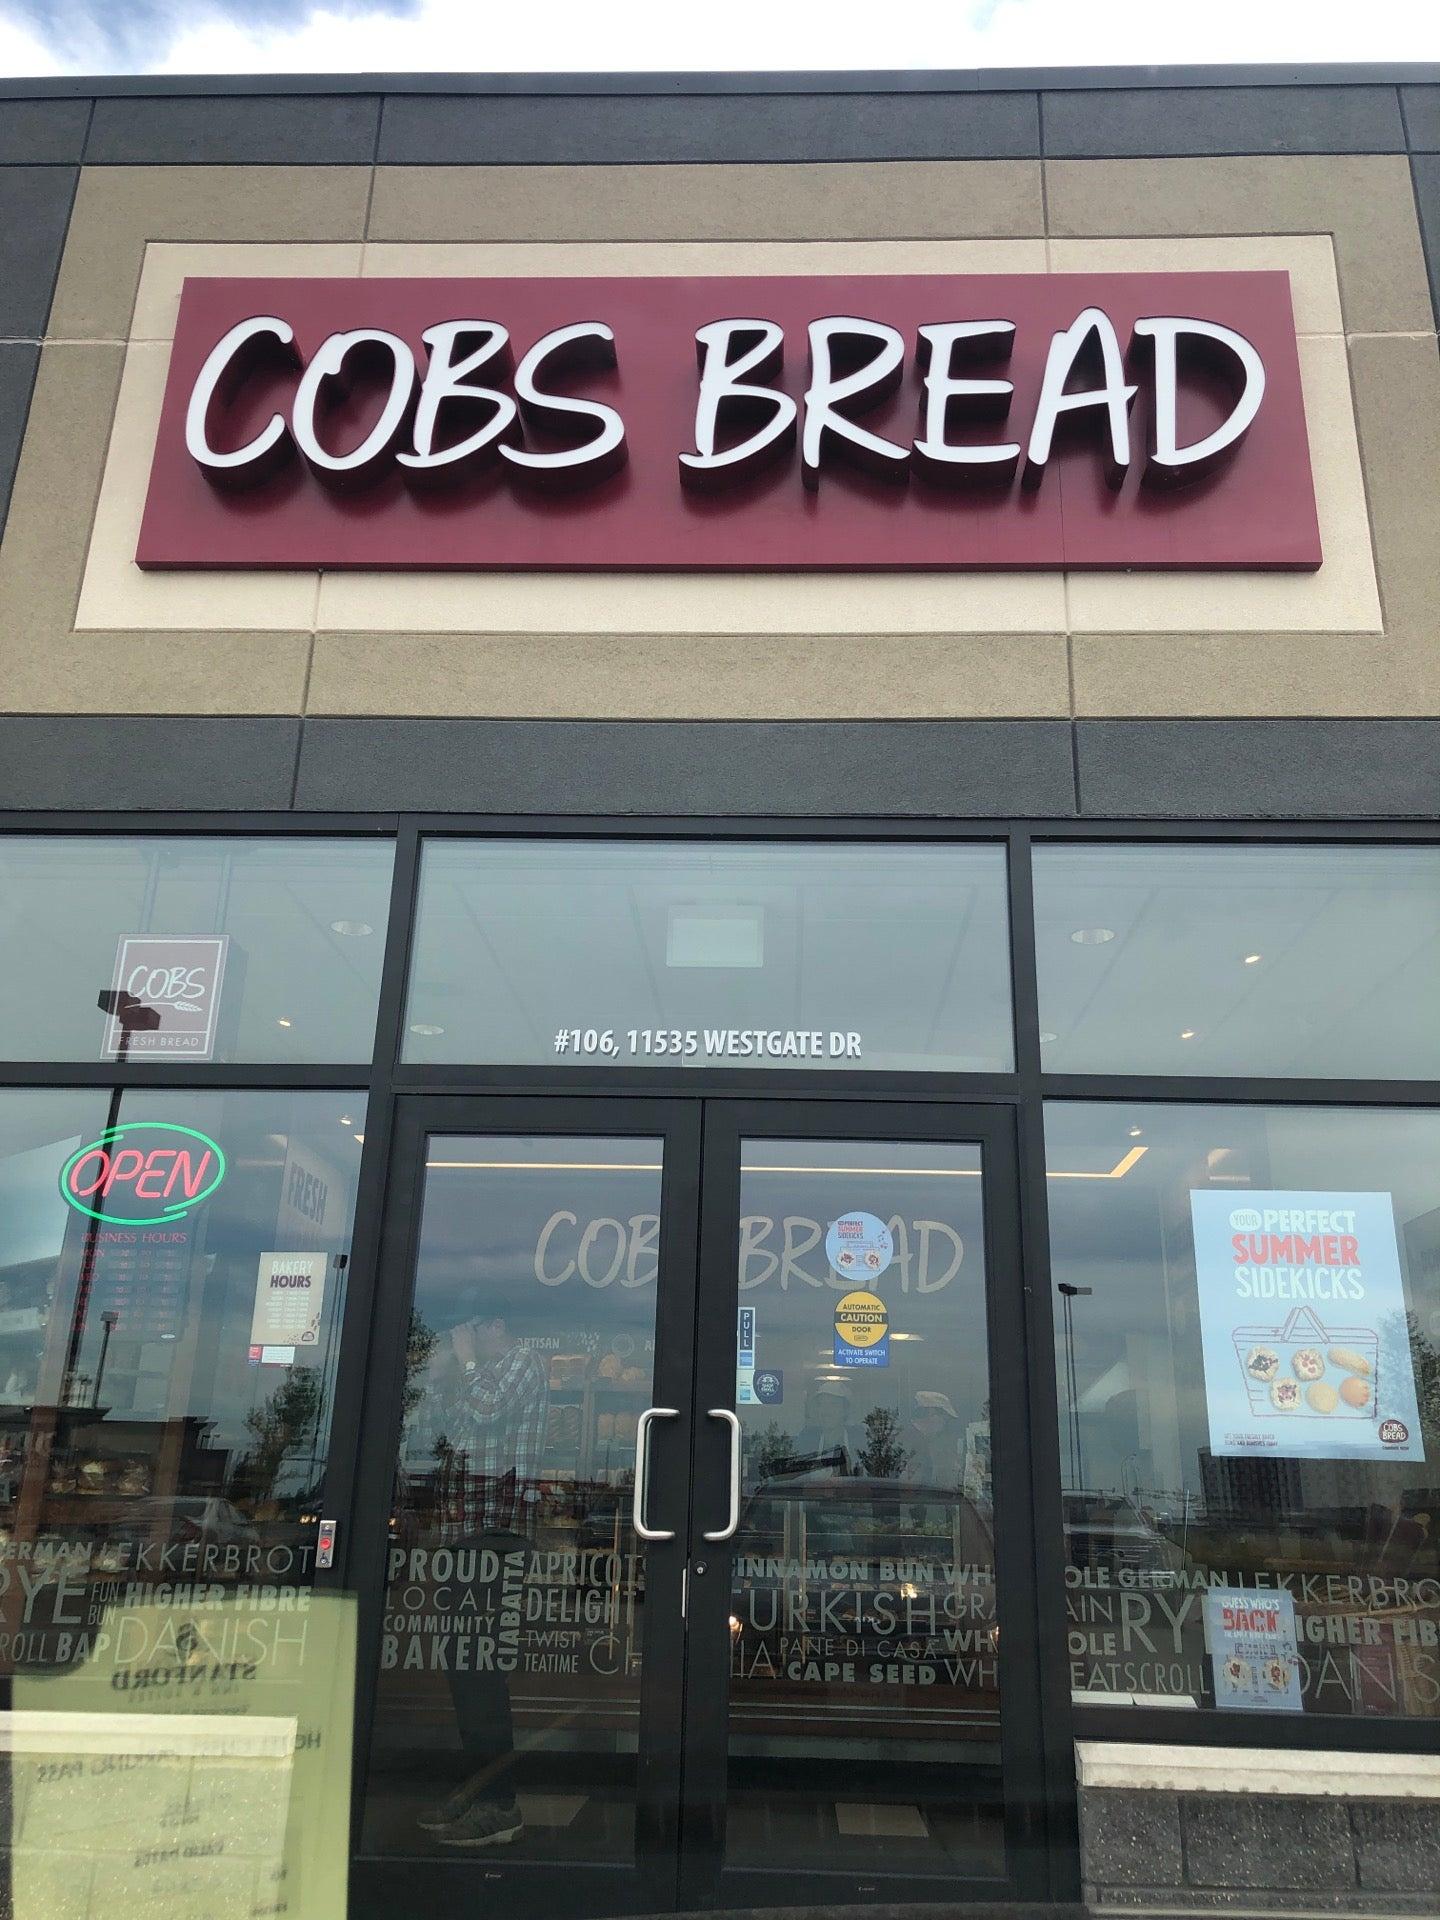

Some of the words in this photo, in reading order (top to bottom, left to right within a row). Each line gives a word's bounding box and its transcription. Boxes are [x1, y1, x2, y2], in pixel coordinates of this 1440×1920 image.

[184, 314, 627, 472] COBS
[677, 305, 1268, 472] BREAD
[126, 964, 206, 999] COBS
[119, 1036, 156, 1046] FRESH
[160, 1037, 199, 1047] BREAD
[553, 1028, 620, 1057] #106,
[626, 1029, 699, 1056] 11535
[703, 1030, 823, 1057] WESTGATE
[829, 1031, 863, 1057] DR
[69, 1148, 213, 1199] OPEN
[1233, 1214, 1259, 1227] YOUR
[1262, 1208, 1356, 1234] PERFECT
[142, 1232, 188, 1244] HOURS
[534, 1210, 661, 1289] COB
[1231, 1233, 1361, 1266] SUMMER
[271, 1260, 314, 1274] BAKERY
[269, 1275, 312, 1289] HOURS
[1234, 1265, 1366, 1300] SIDEKICKS
[840, 1312, 883, 1323] CAUTION
[842, 1303, 881, 1311] AUTOMATIC
[838, 1348, 863, 1356] ACTIVATE
[864, 1349, 886, 1357] SWITCH
[1382, 1431, 1407, 1440] BREAD
[1383, 1423, 1403, 1432] COBS
[0, 1541, 93, 1562] ERMAN
[99, 1541, 315, 1575] LEKKERBROT
[386, 1548, 499, 1583] PROUD
[879, 1560, 935, 1583] BUN
[1065, 1565, 1109, 1589] OLE
[1118, 1567, 1229, 1590] GERMAN
[91, 1580, 120, 1604] FUN
[123, 1582, 226, 1612] HIGHER
[233, 1584, 312, 1613] FIBRE
[385, 1586, 496, 1612] LOCAL
[1250, 1598, 1280, 1611] WHO'S
[87, 1604, 117, 1626] BUN
[497, 1549, 526, 1672] CIABATTA
[525, 1587, 638, 1625] DELIGHT
[732, 1588, 936, 1636] URKISH
[382, 1613, 497, 1634] COMMUNITY
[1119, 1591, 1196, 1654] RY
[1222, 1608, 1280, 1632] BACK
[1294, 1614, 1383, 1646] IGHER
[1392, 1616, 1440, 1647] FIB
[55, 1631, 111, 1664] BAP
[113, 1615, 307, 1667] DANISH
[525, 1629, 579, 1650] TWIST
[779, 1636, 835, 1657] PANE
[846, 1639, 866, 1658] DI
[876, 1640, 938, 1660] CASA
[1067, 1631, 1117, 1656] OLE
[381, 1634, 498, 1672] BAKER
[524, 1652, 579, 1674] TEATIME
[787, 1660, 856, 1683] CAPE
[869, 1663, 937, 1686] SEED
